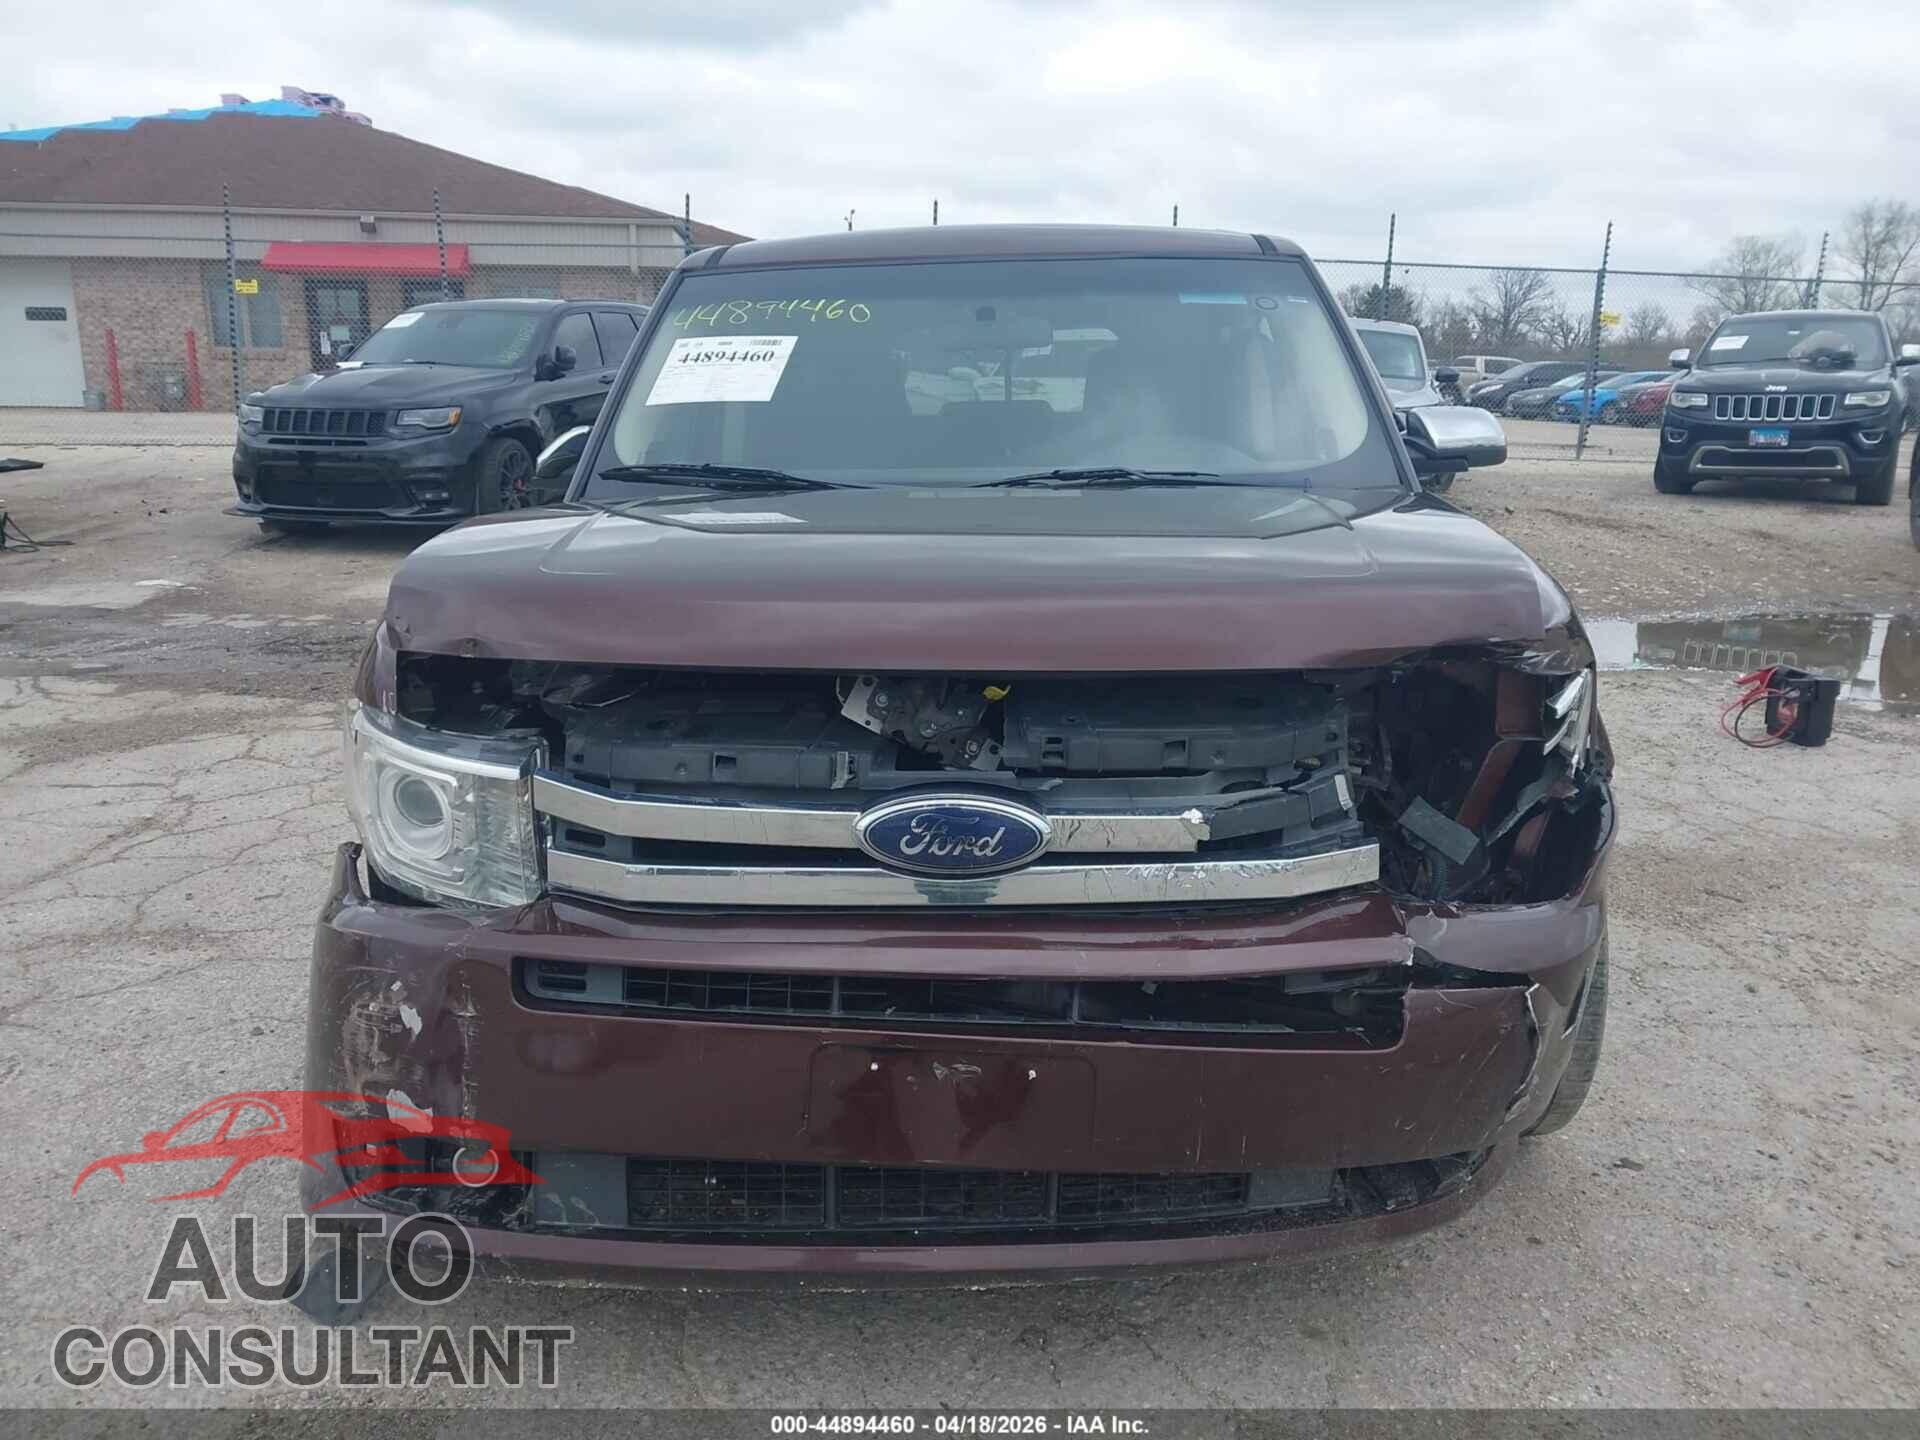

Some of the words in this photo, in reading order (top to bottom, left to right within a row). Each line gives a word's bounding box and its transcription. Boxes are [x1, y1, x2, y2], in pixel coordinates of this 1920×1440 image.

[673, 299, 871, 329] 44894460
[677, 350, 775, 364] 44894460
[1765, 384, 1788, 392] Jeep
[900, 813, 1005, 857] Ford
